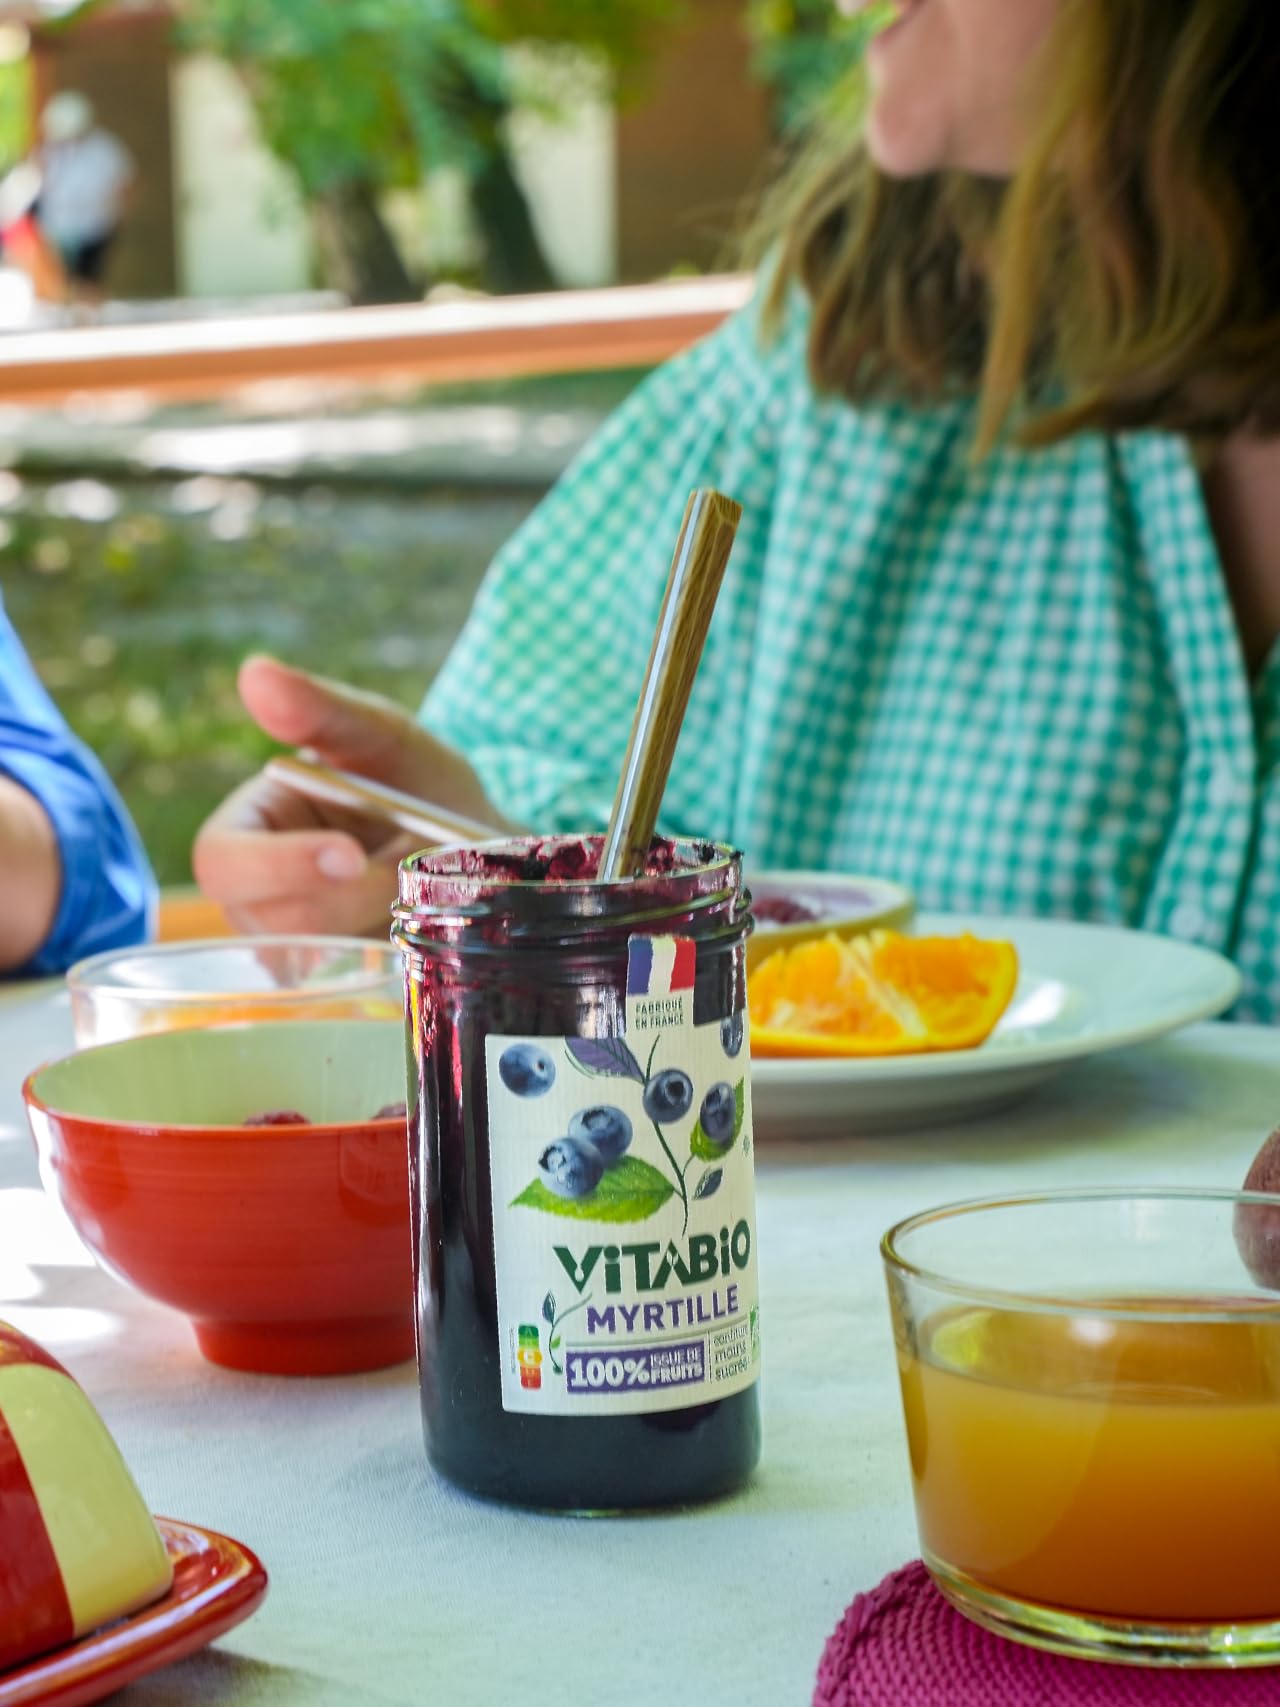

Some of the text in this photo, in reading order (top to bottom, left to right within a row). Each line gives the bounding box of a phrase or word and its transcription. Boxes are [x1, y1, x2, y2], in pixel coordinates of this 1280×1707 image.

[636, 997, 682, 1014] FABRIQUÉ
[635, 1013, 684, 1030] EN FRANCE
[587, 1285, 738, 1334] MYRTILLE
[714, 1341, 746, 1364] moins
[570, 1356, 650, 1388] 100%
[650, 1362, 702, 1385] FRUITS
